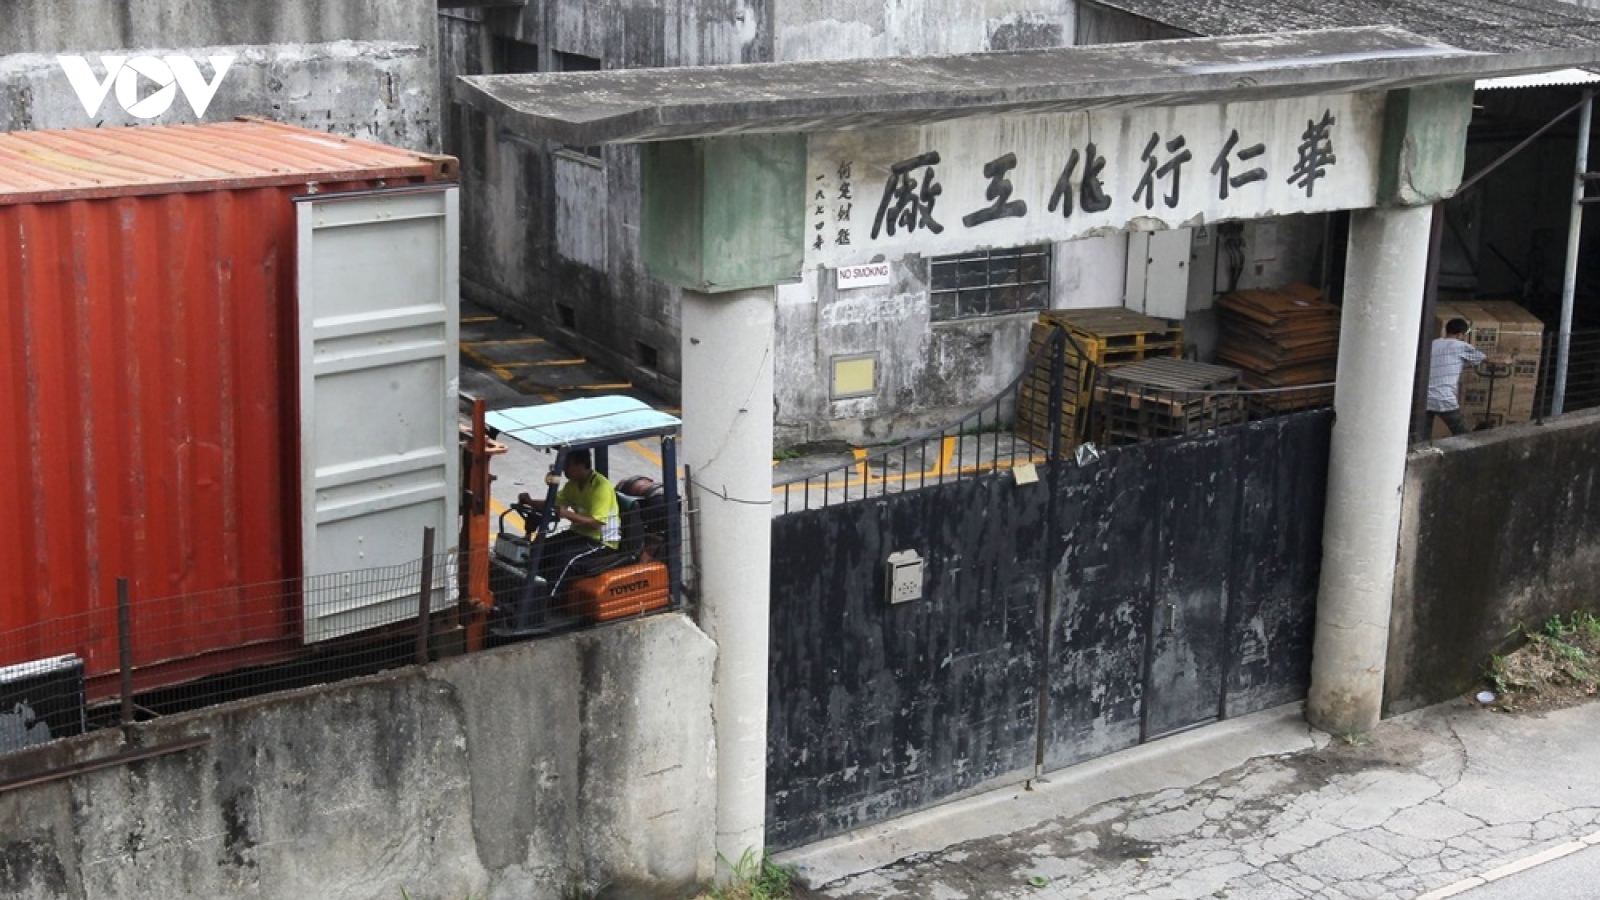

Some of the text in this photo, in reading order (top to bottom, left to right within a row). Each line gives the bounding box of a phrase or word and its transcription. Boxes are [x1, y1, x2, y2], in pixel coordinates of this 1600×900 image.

[839, 265, 889, 280] NO SMOKING
[609, 579, 649, 596] TOYOTA
